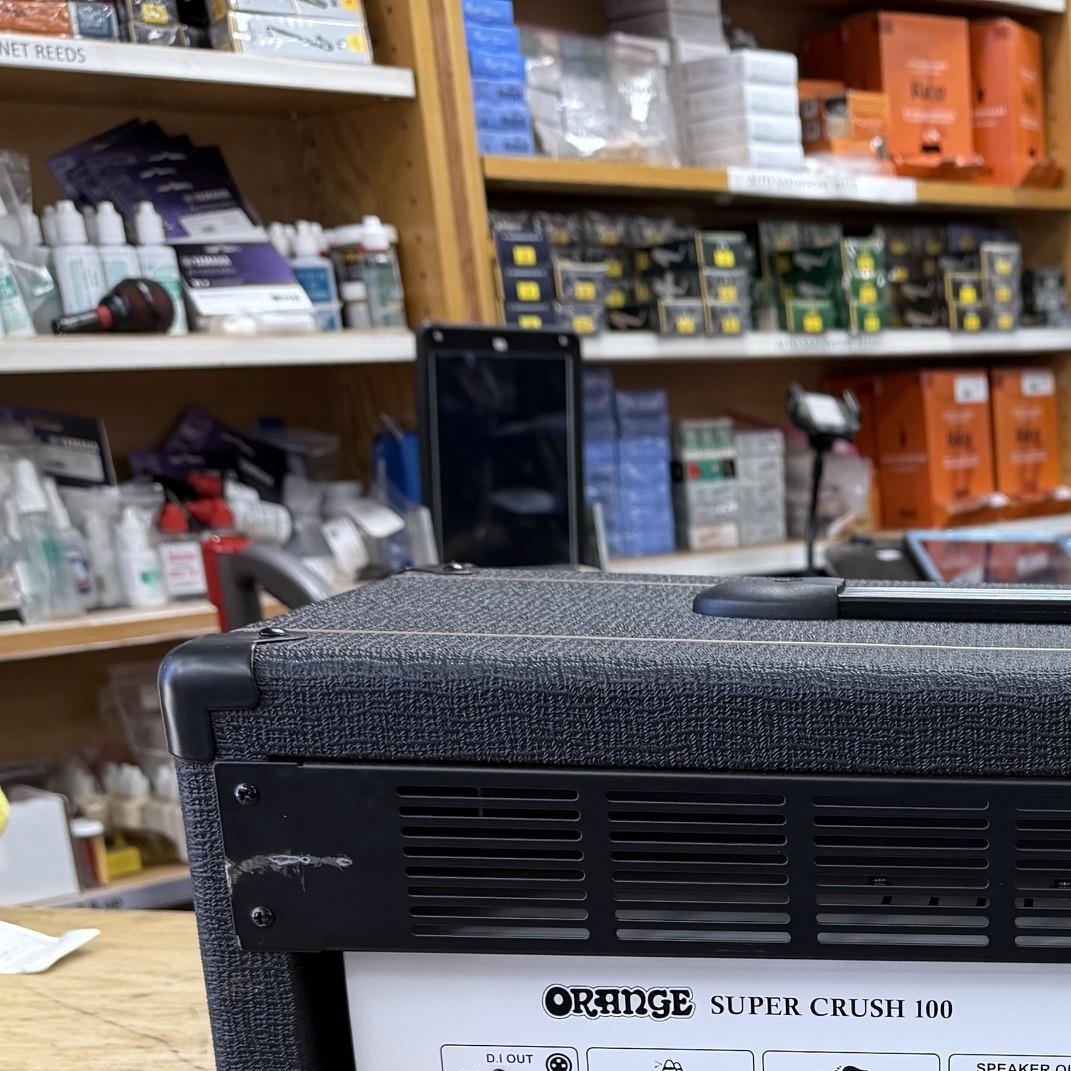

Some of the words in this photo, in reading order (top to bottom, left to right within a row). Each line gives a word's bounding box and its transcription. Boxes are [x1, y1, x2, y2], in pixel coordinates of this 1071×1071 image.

[35, 43, 87, 64] REEDS
[543, 984, 695, 1021] ORANGE
[711, 995, 803, 1016] SUPER
[810, 997, 905, 1018] CRUSH
[915, 999, 953, 1019] 100
[507, 1054, 534, 1063] OUT
